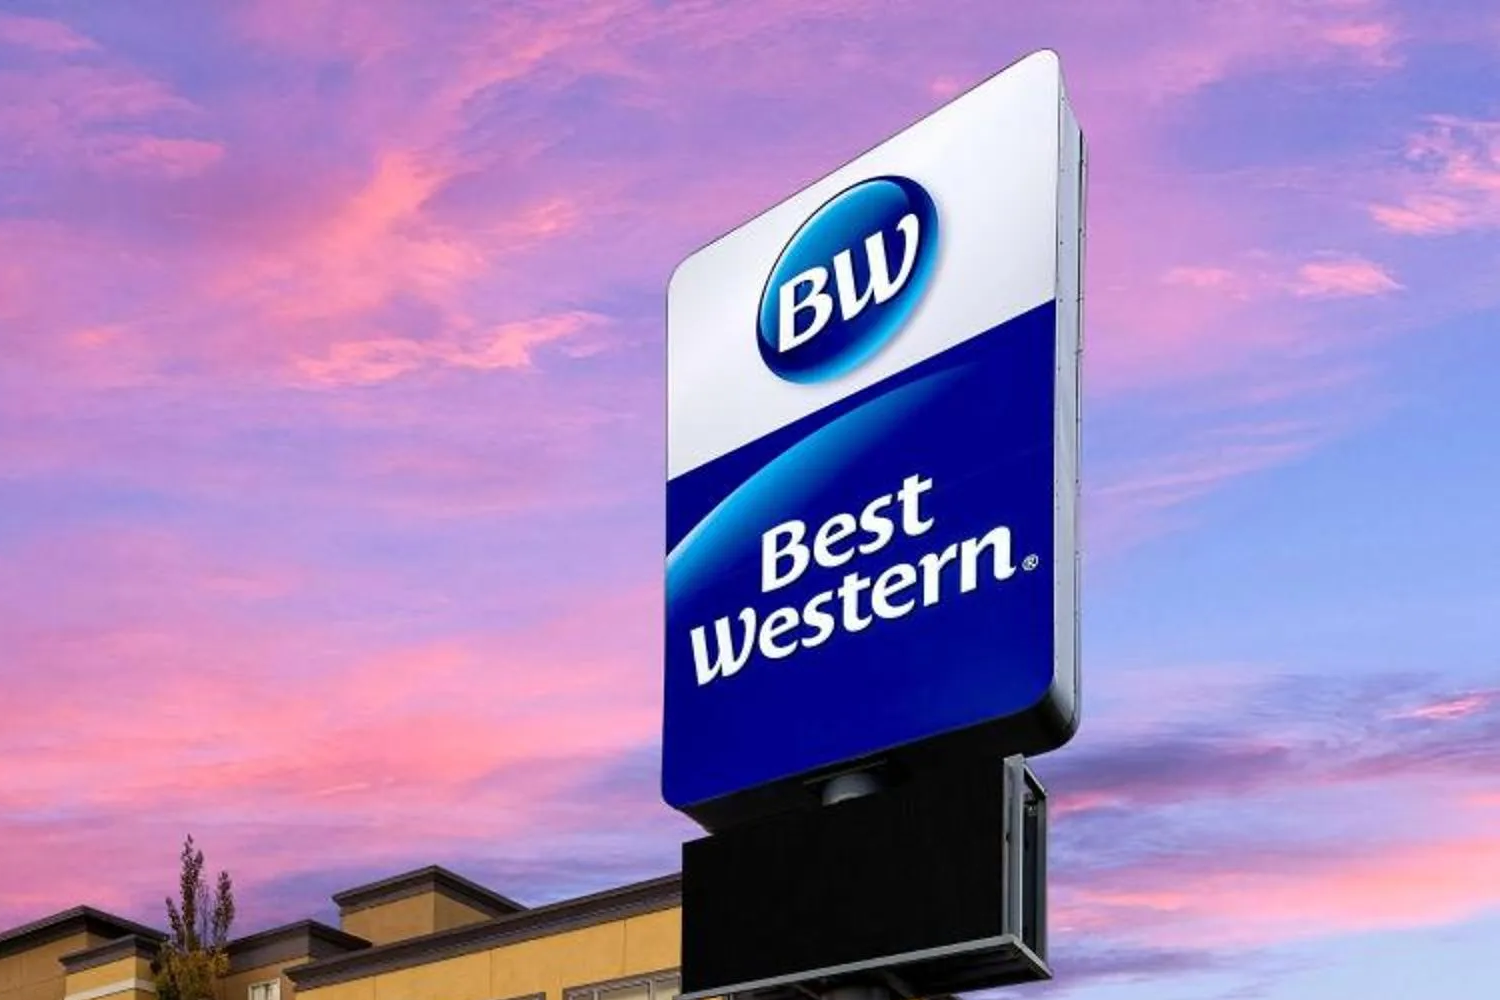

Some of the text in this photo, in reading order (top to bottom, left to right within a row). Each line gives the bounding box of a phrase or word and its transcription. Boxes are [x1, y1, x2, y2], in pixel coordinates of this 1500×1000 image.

[777, 212, 920, 354] BW
[760, 472, 935, 594] Best
[688, 524, 1018, 687] Western
